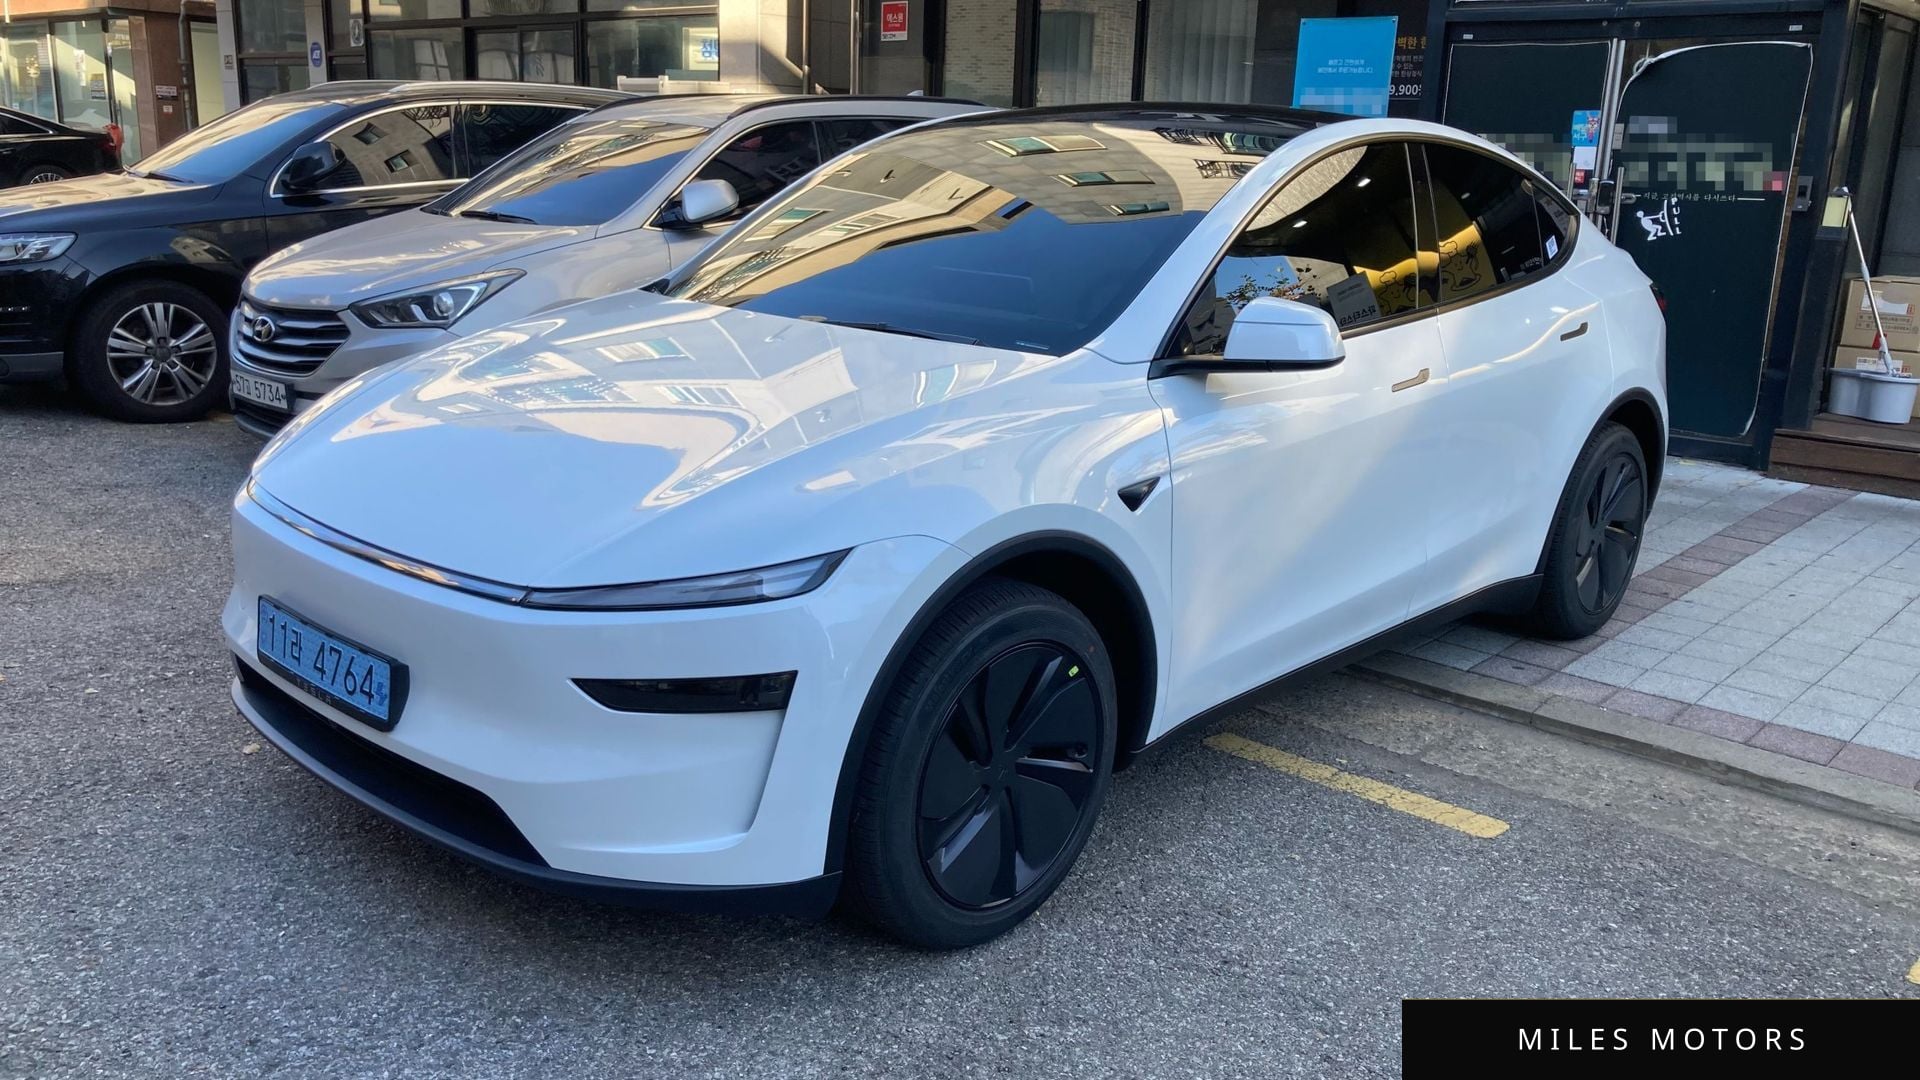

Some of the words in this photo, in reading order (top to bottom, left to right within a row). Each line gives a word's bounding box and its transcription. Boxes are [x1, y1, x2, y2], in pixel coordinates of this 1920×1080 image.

[1397, 36, 1417, 49] 벽한
[1671, 197, 1682, 235] PULL
[253, 380, 283, 405] 5734
[268, 612, 303, 667] 11라
[312, 640, 375, 706] 4764
